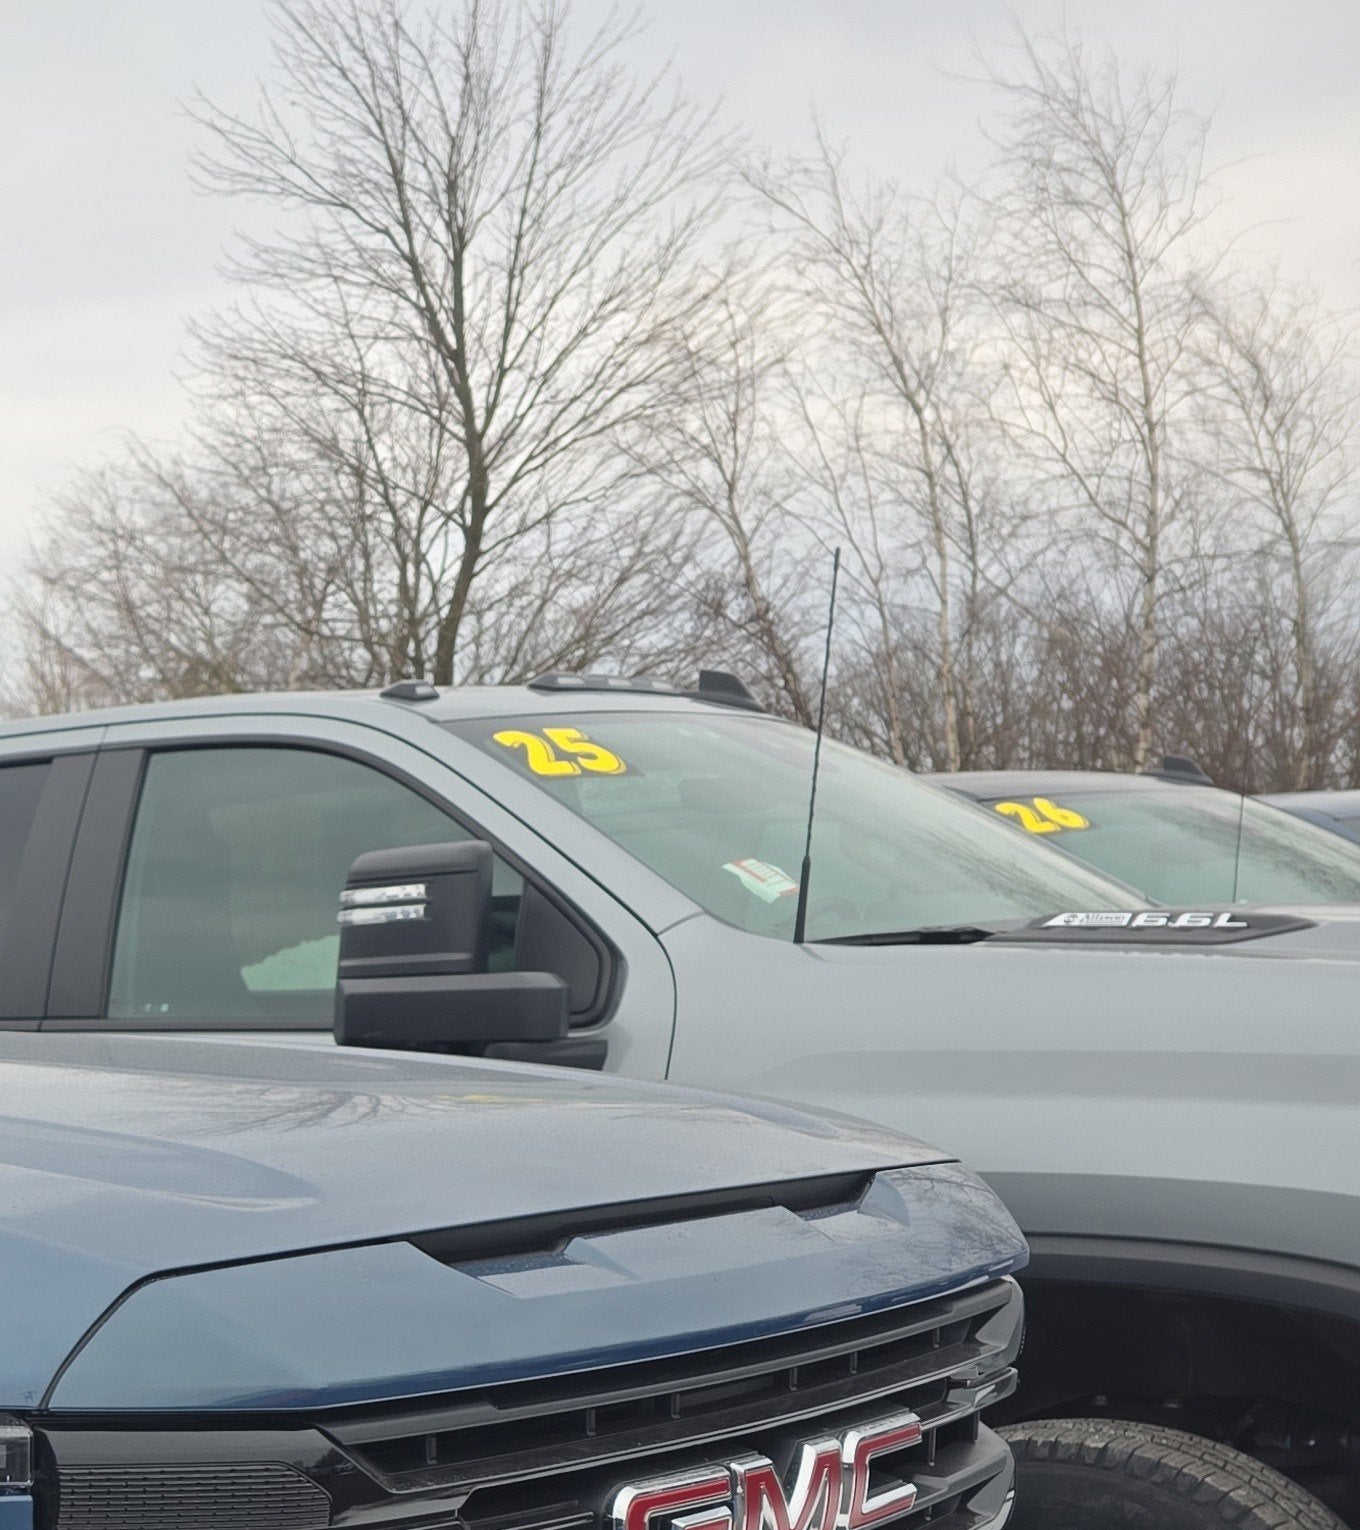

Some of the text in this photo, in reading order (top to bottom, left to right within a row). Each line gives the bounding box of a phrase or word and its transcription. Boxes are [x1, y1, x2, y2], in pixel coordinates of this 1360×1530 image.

[493, 728, 627, 776] 25
[995, 797, 1089, 834] 26
[1132, 912, 1248, 927] 6.6L
